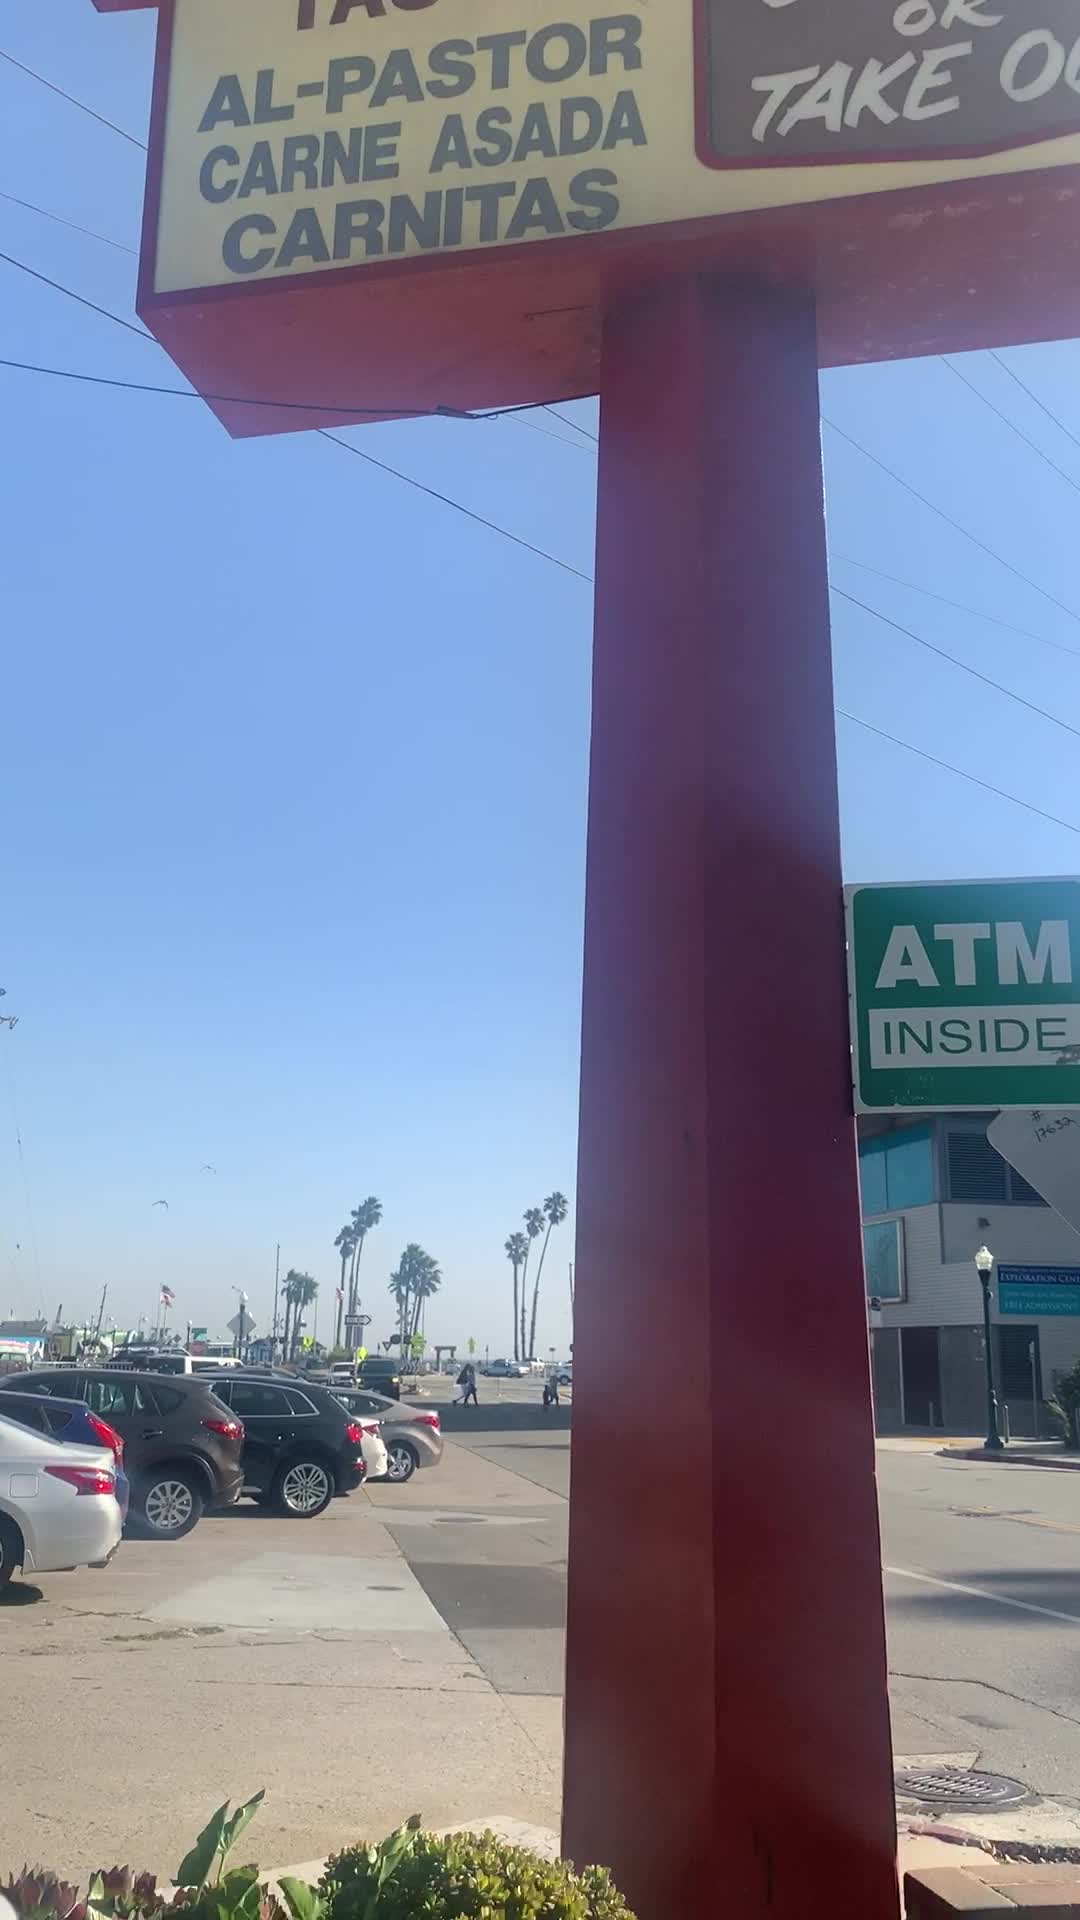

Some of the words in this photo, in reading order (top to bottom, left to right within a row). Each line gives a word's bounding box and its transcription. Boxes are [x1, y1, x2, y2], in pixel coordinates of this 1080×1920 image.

[196, 14, 643, 133] AL-PASTOR
[751, 40, 973, 143] TAKE
[199, 121, 402, 204] CARNE
[428, 90, 648, 174] ASADA
[221, 168, 620, 275] CARNITAS
[874, 920, 1073, 989] ATM
[883, 1017, 1067, 1054] INSIDE
